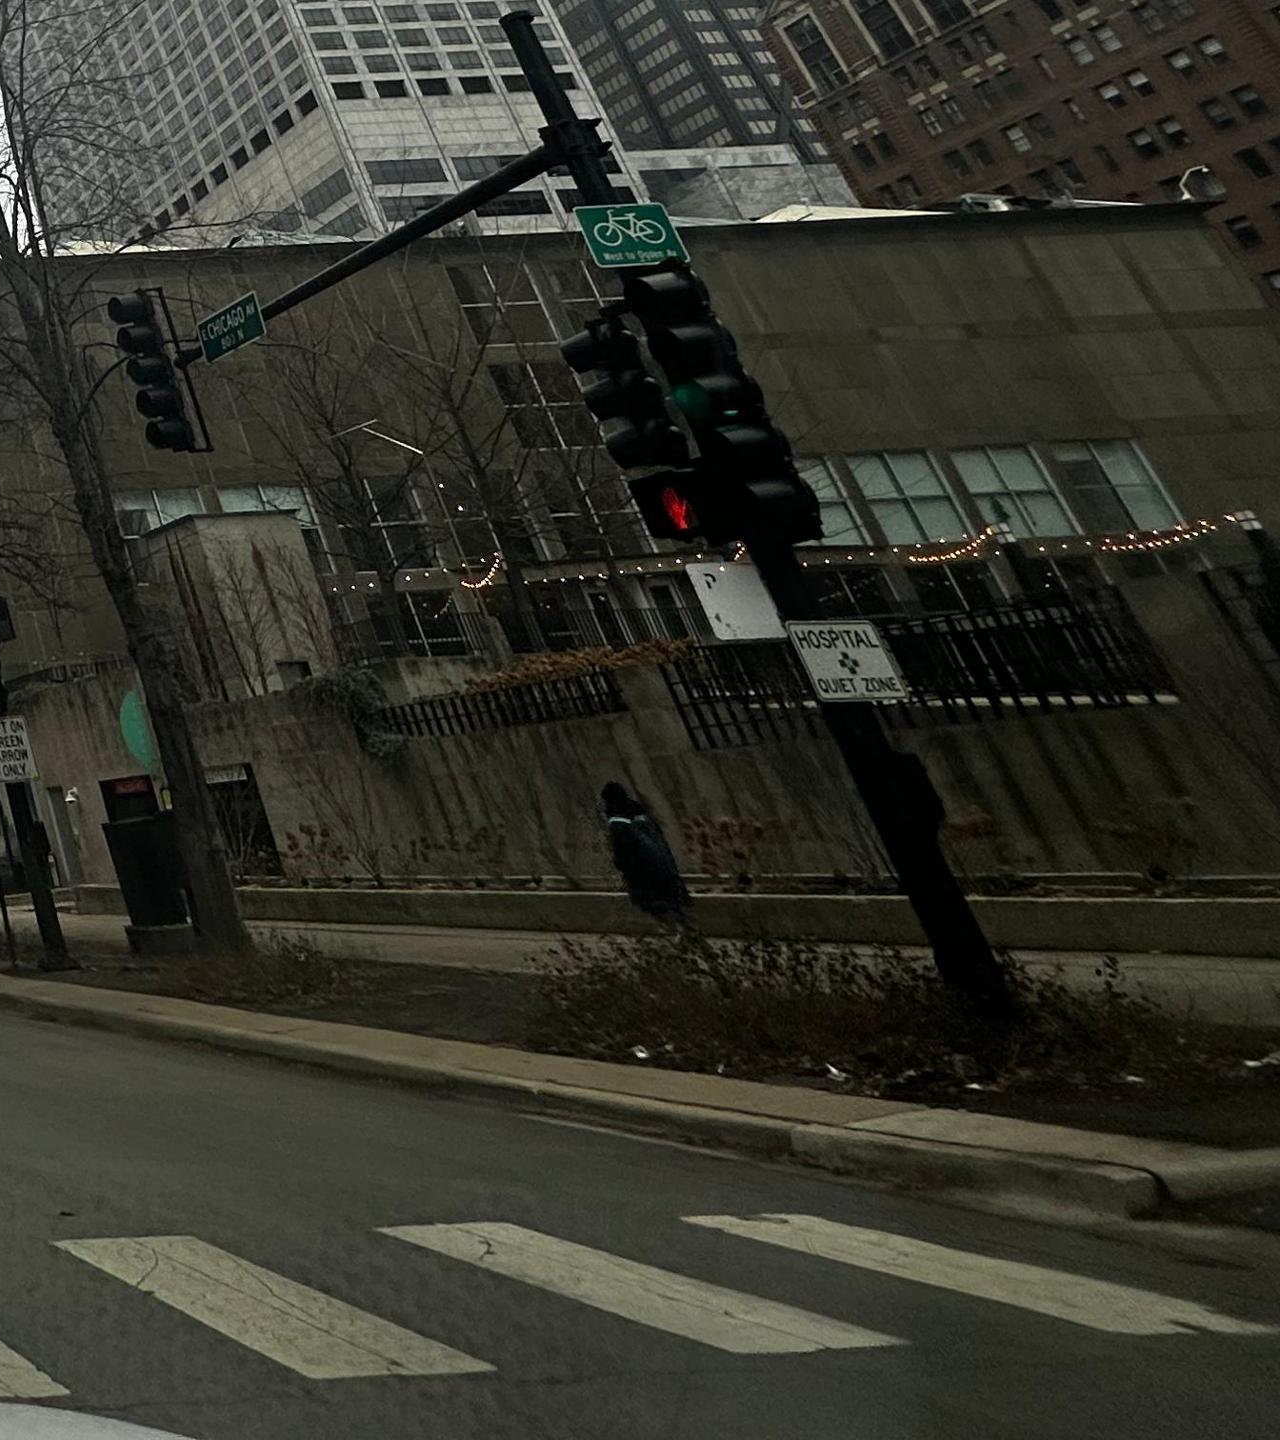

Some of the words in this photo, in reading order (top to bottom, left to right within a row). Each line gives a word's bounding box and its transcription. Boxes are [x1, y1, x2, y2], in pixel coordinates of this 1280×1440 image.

[201, 329, 209, 341] E
[207, 306, 245, 339] CHICAGO
[793, 629, 880, 650] HOSPITAL
[817, 677, 857, 694] QUIET
[859, 676, 901, 693] ZONE
[9, 720, 25, 734] ON
[2, 762, 27, 777] ONLY
